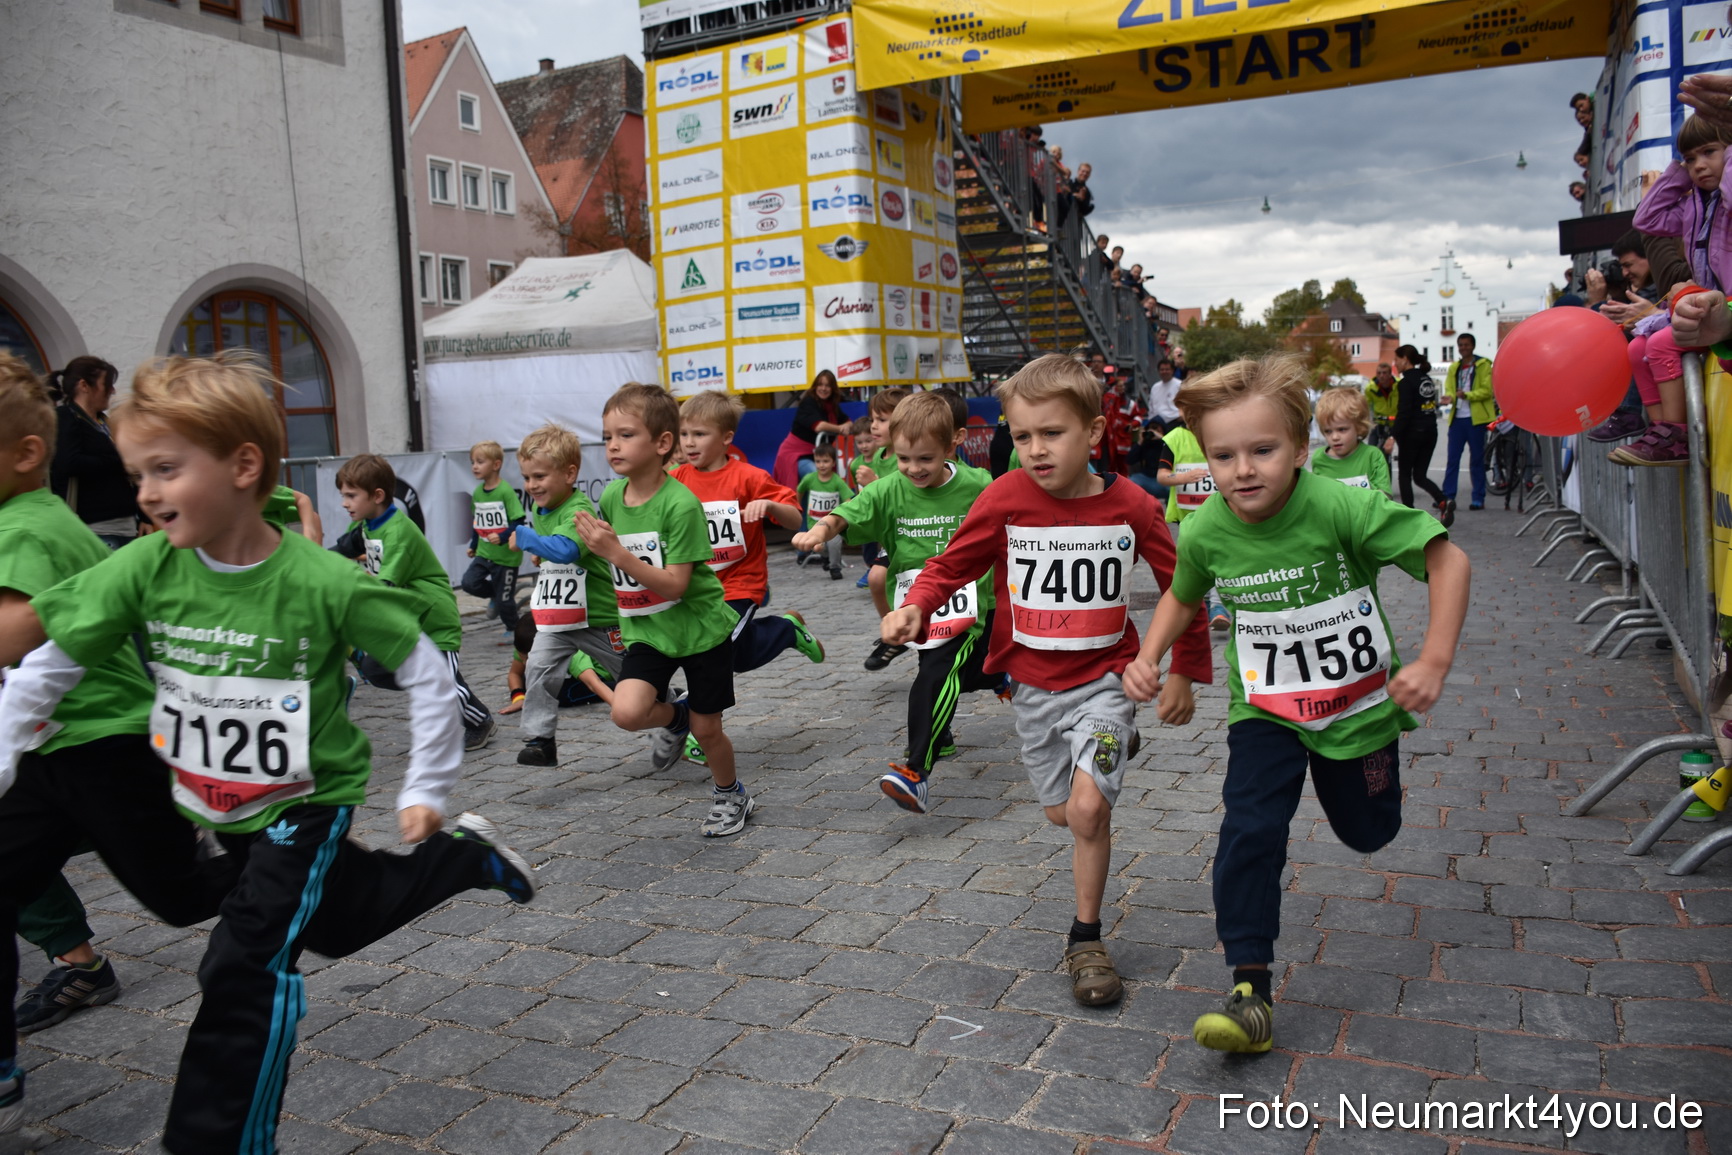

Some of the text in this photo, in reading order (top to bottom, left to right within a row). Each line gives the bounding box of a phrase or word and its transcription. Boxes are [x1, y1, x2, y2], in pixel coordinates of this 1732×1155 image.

[886, 21, 1028, 55] Neumarkter Stadtlauf
[1417, 16, 1575, 50] Neumarkter Stadtlauf
[1153, 19, 1376, 93] START
[1061, 80, 1116, 98] Stadtlauf
[735, 252, 801, 273] RÖDL
[671, 363, 723, 383] RÖDL
[754, 358, 803, 372] VARIOTEC
[811, 498, 837, 511] 7102
[476, 512, 503, 527] 7190
[896, 514, 955, 527] Neumarkter
[897, 526, 944, 539] Stadtlauf
[1009, 537, 1046, 551] PARTL
[1049, 539, 1113, 552] Neumarkt
[1015, 556, 1122, 603] 7400
[1214, 565, 1305, 589] Neumarkter
[1219, 586, 1289, 606] Stadtlauf
[1017, 609, 1072, 631] FELIX
[1237, 607, 1356, 636] PARTL Neumarkt
[146, 620, 259, 648] Neumarkter
[150, 640, 232, 671] Stadtlauf
[1252, 625, 1378, 687] 7158
[190, 690, 274, 711] Neumarkt
[1293, 693, 1349, 718] Timm
[163, 704, 289, 778] 7126
[203, 783, 242, 808] Tim
